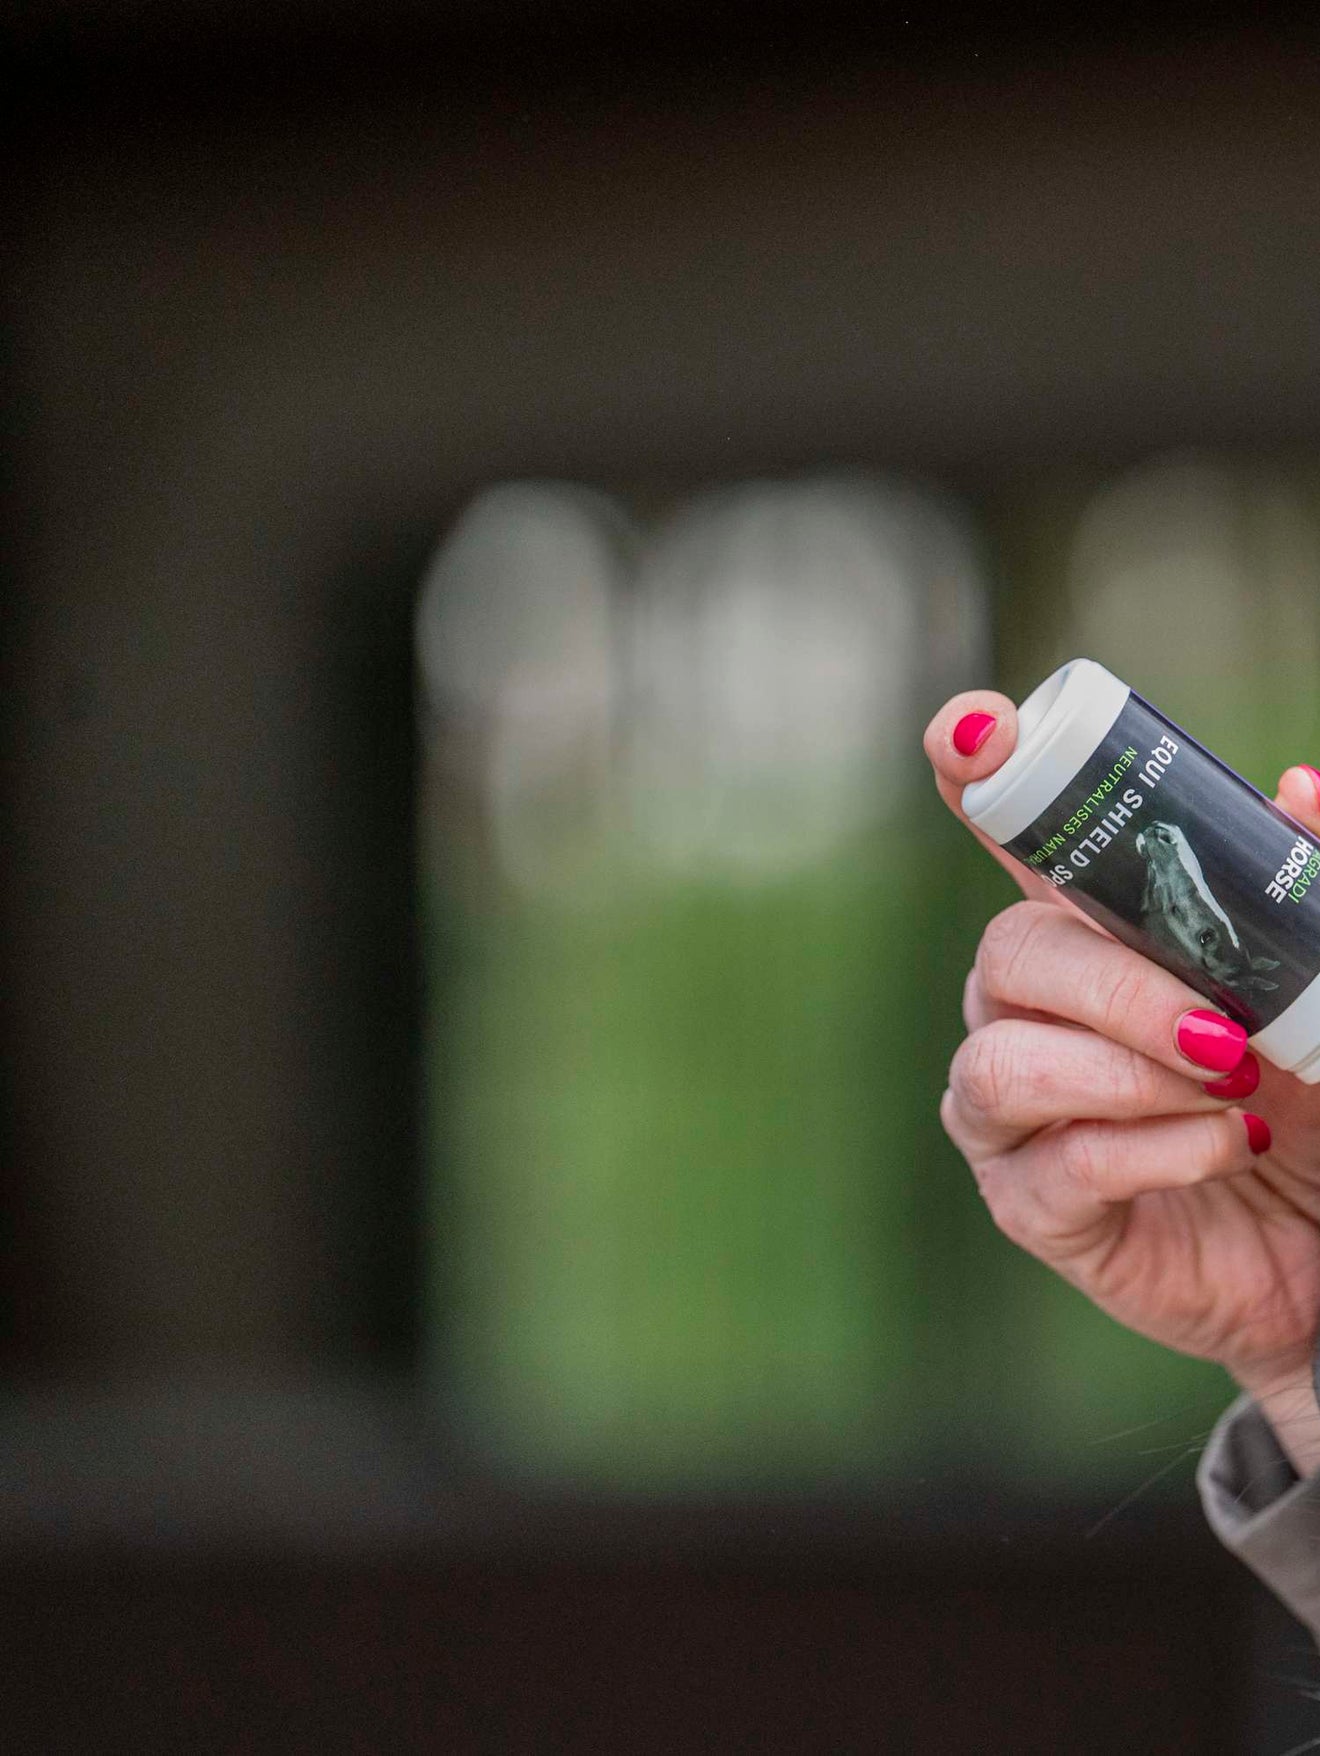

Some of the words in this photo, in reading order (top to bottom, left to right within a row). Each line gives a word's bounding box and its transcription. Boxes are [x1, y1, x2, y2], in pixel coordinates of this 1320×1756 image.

[1063, 746, 1138, 835] NEUTRALISES
[1138, 735, 1179, 788] EQUI
[1069, 788, 1143, 868] SHIELD
[1040, 864, 1074, 888] SPO
[1264, 836, 1314, 904] HORSE
